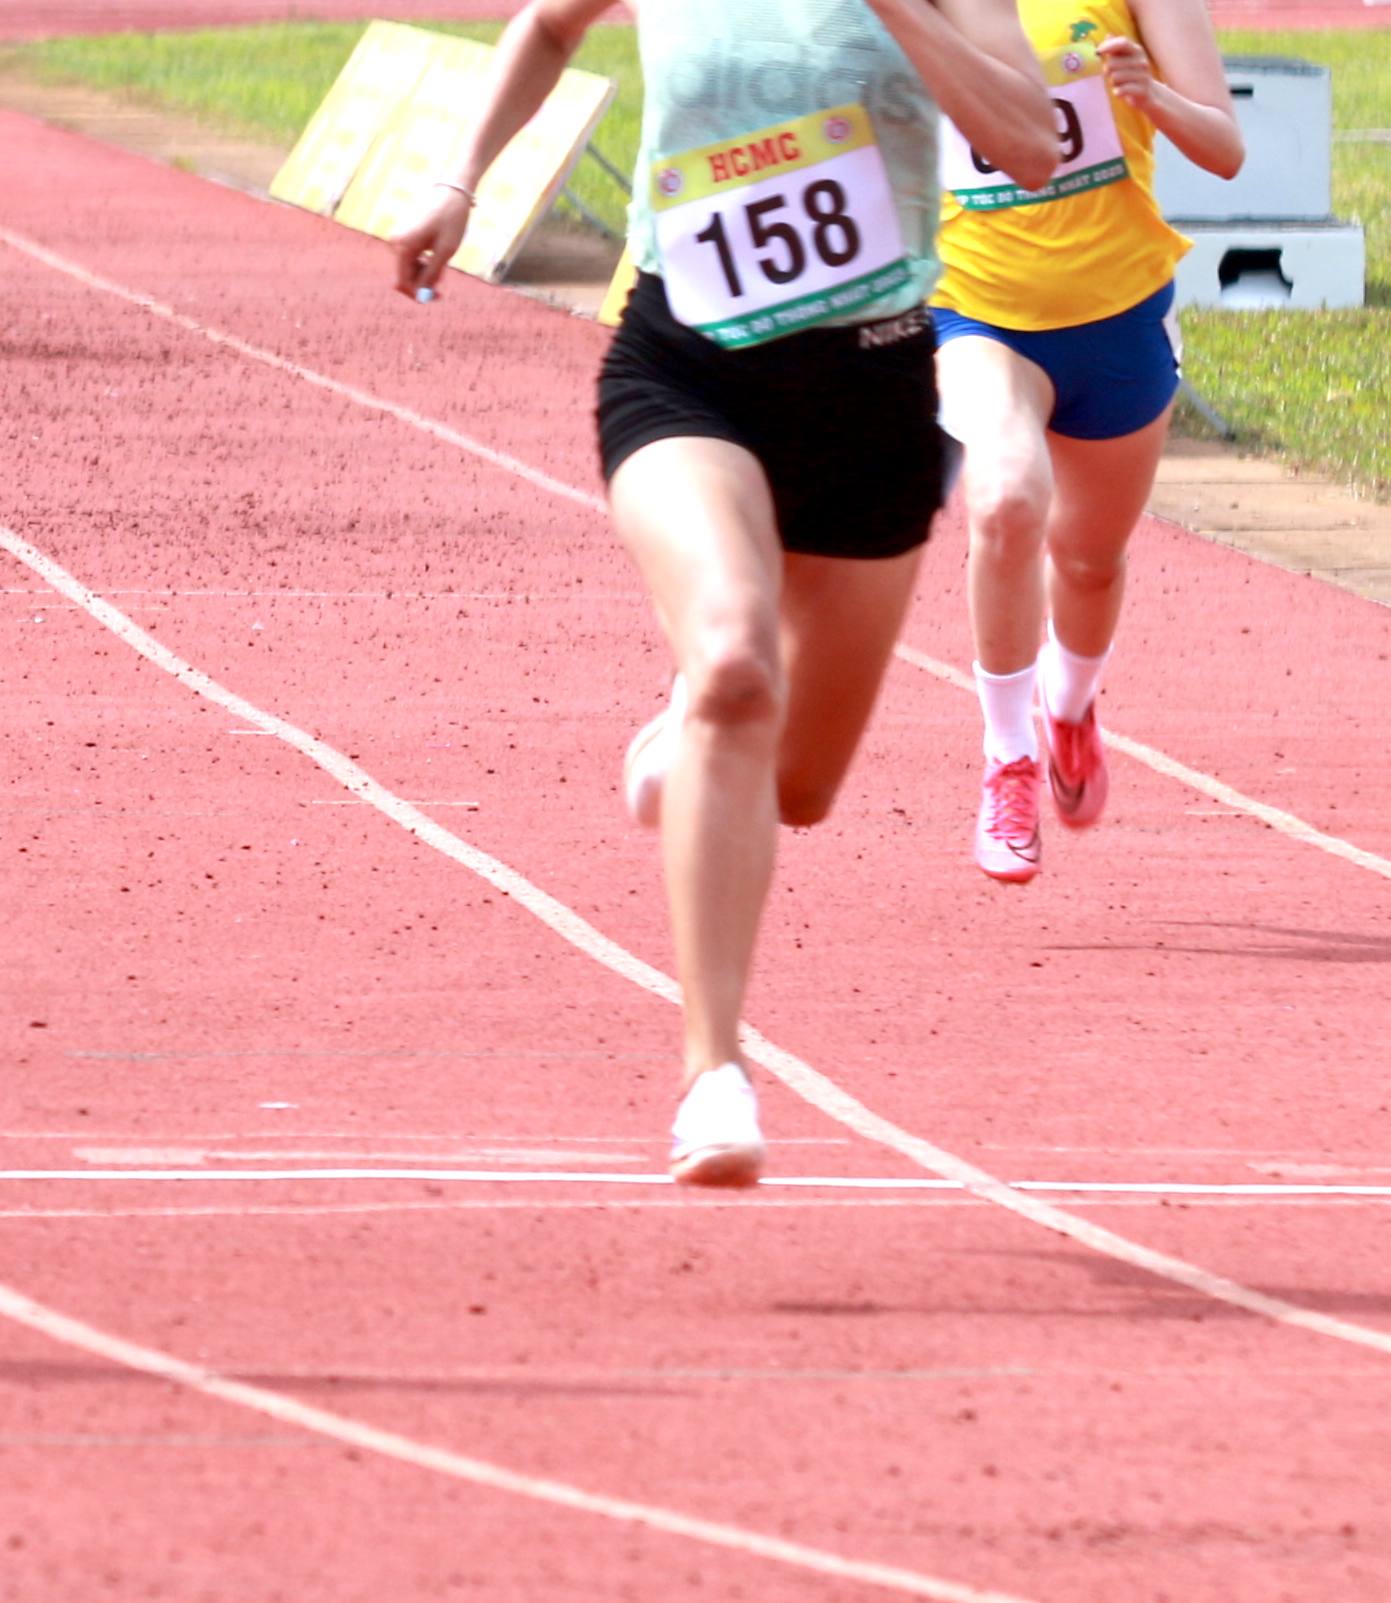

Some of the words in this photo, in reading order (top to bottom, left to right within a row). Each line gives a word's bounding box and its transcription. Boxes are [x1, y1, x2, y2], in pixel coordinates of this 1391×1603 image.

[708, 132, 801, 184] HCMC
[695, 179, 861, 298] 158
[858, 307, 929, 349] NIKE
